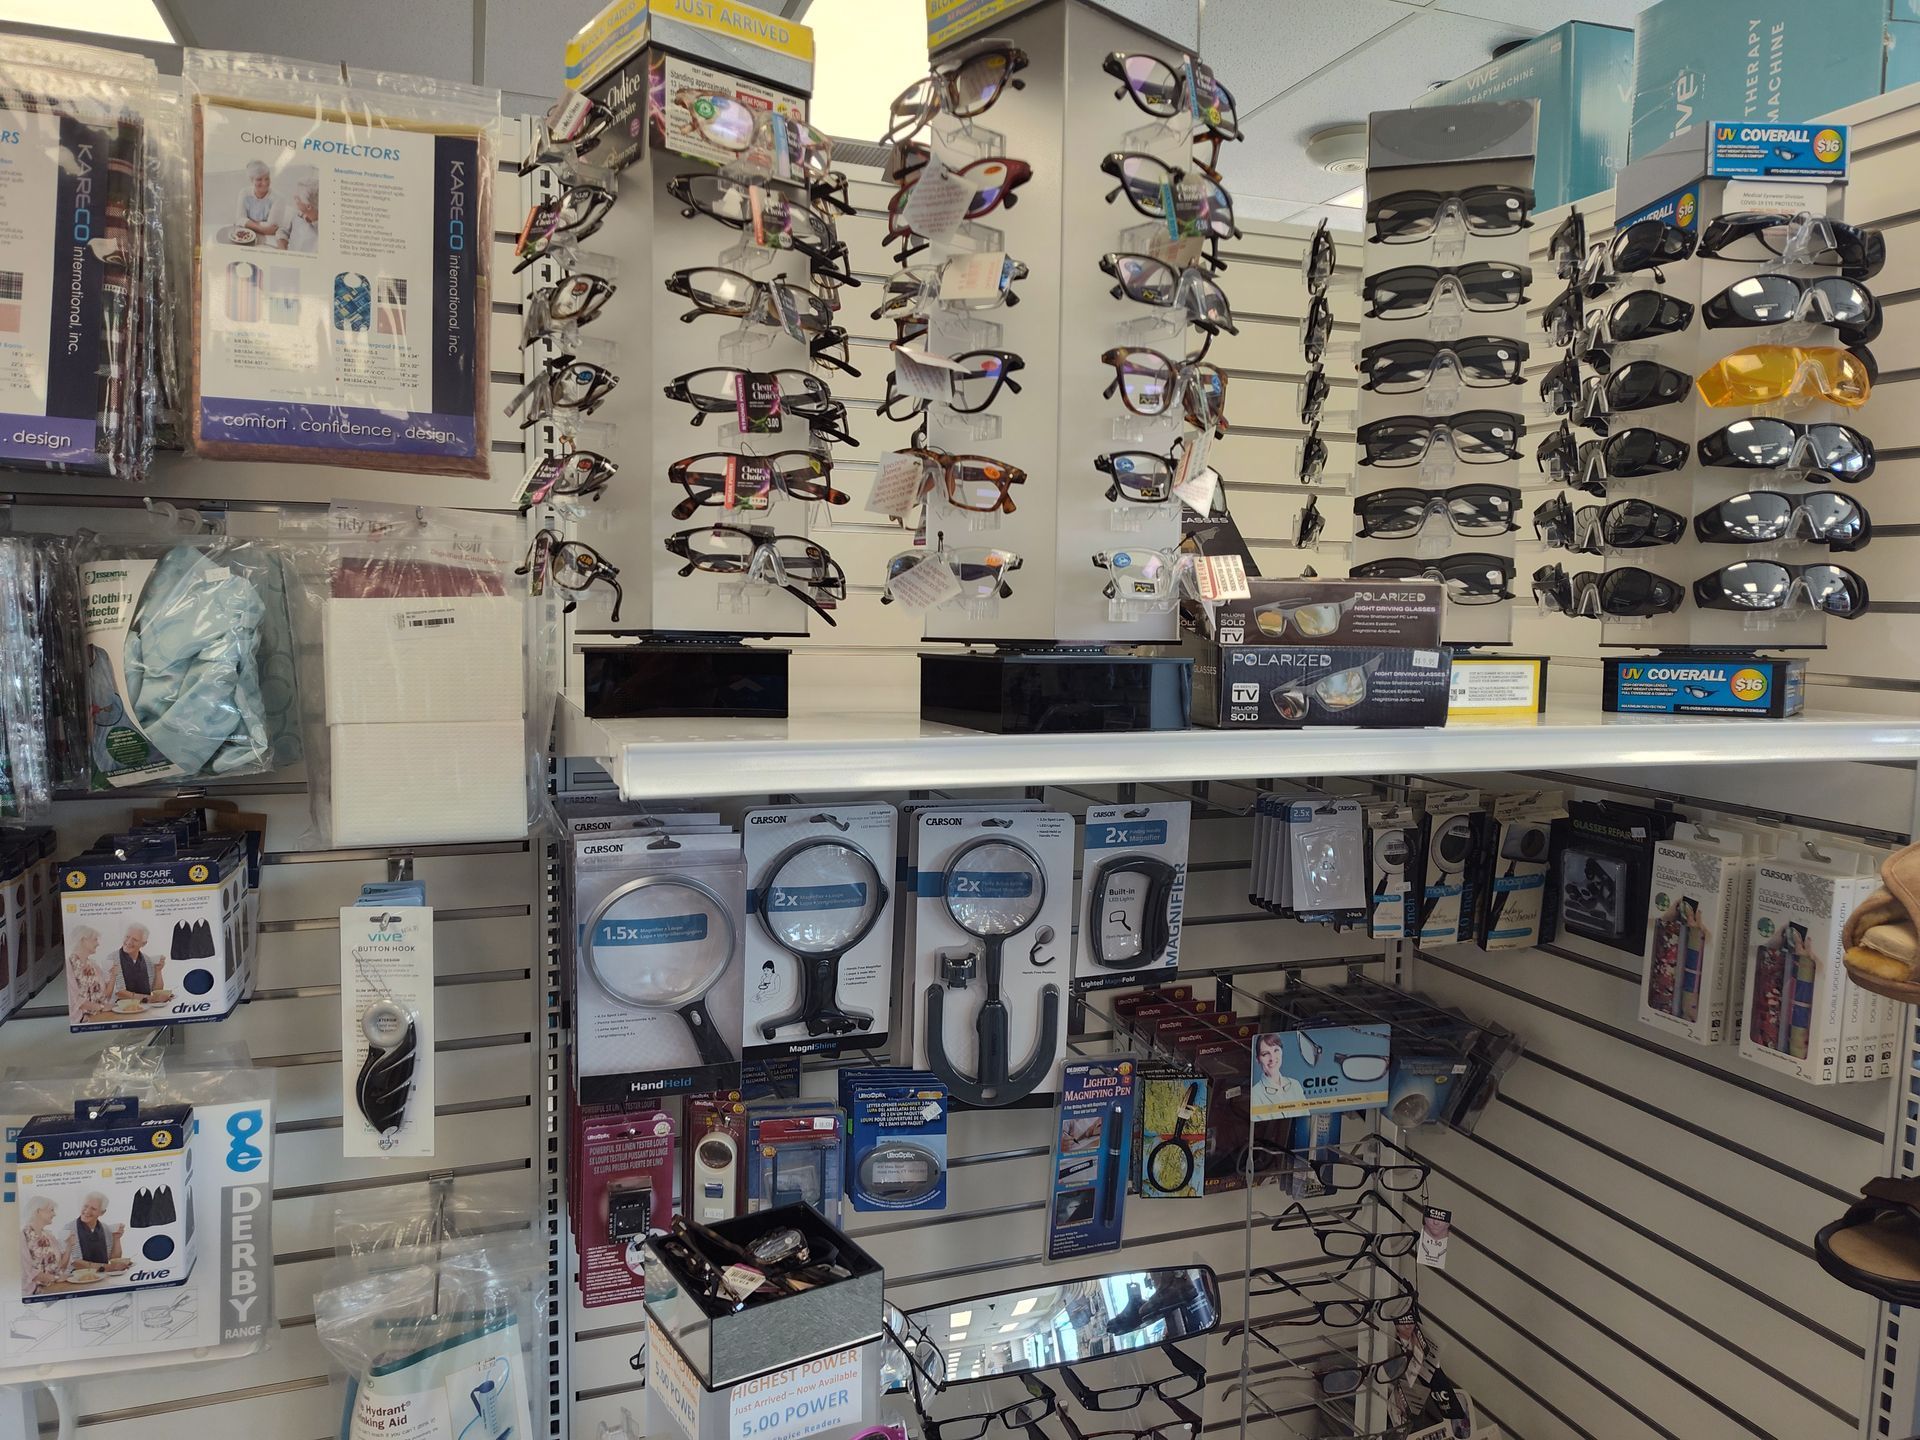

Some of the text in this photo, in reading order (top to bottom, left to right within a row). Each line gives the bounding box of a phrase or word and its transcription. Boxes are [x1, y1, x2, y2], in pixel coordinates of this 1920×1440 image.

[720, 9, 789, 44] ARRIVED
[1744, 19, 1761, 117] THERAPY
[1767, 21, 1784, 123] MACHINE
[1717, 128, 1810, 143] UV COVERALL
[240, 131, 400, 161] Clothing PROTECTORS
[1816, 138, 1841, 153] $16
[1678, 201, 1693, 219] $16
[67, 144, 92, 356] KARECO international, inc.
[447, 160, 465, 357] KARECO international, inc.
[752, 382, 773, 391] Clear
[753, 391, 779, 400] Choice
[223, 412, 456, 444] comfort confidence design
[13, 429, 71, 450] design
[742, 465, 762, 473] Clear
[742, 473, 770, 481] Choice
[1354, 591, 1426, 602] POLARIZED
[1222, 632, 1243, 642] TV
[1232, 654, 1331, 666] POLARIZED
[1622, 668, 1727, 682] UV COVERALL
[1735, 677, 1763, 691] $16
[1234, 689, 1257, 700] TV
[1231, 713, 1258, 721] SOLD
[750, 815, 788, 824] CARSON
[1093, 810, 1116, 818] CARSON
[1293, 809, 1310, 817] 2.5x
[575, 822, 611, 831] CARSON
[925, 817, 963, 826] CARSON
[1573, 819, 1606, 833] GLASSES
[1105, 827, 1129, 844] 2x
[1129, 834, 1160, 842] Magnifier
[583, 844, 624, 854] CARSON
[1658, 847, 1686, 860] CARSON
[104, 869, 172, 880] DINING SCARF
[1656, 872, 1705, 889] CLEANING CLOTH
[1760, 868, 1793, 882] CARSON
[138, 878, 176, 886] CHARCOAL
[956, 876, 982, 892] 2x
[1109, 888, 1135, 896] Built-in
[774, 892, 798, 907] 2x
[1758, 895, 1815, 914] CLEANING CLOTH
[1165, 862, 1185, 966] MAGNIFIER
[1405, 897, 1415, 924] inch
[602, 926, 638, 940] 1.5x
[1080, 980, 1104, 989] Lighted
[172, 1002, 211, 1014] drive
[789, 1042, 837, 1053] MagniShine
[1796, 1065, 1802, 1076] 2
[631, 1077, 692, 1092] HandHeld
[1083, 1076, 1118, 1088] LIGHTED
[1064, 1085, 1131, 1102] MAGNIFYING PEN
[63, 1136, 133, 1150] DINING SCARF
[98, 1145, 137, 1154] CHARCOAL
[590, 1137, 668, 1155] POWERFUL 5X LINEN TESTER LOUPE
[589, 1147, 668, 1165] 5X LOUPE TESTEUR PUISSANT DU LINGE
[600, 1164, 611, 1173] LUPA
[629, 1160, 646, 1169] FUERTE
[646, 1159, 653, 1167] DE
[652, 1157, 663, 1166] LINO
[228, 1186, 262, 1323] DERBY
[131, 1268, 170, 1282] drive
[225, 1324, 262, 1339] RANGE
[732, 1367, 798, 1401] HIGHEST
[802, 1349, 858, 1379] POWER
[735, 1370, 858, 1416] Just Arrived Now Available
[743, 1389, 849, 1437] 5.00 POWER
